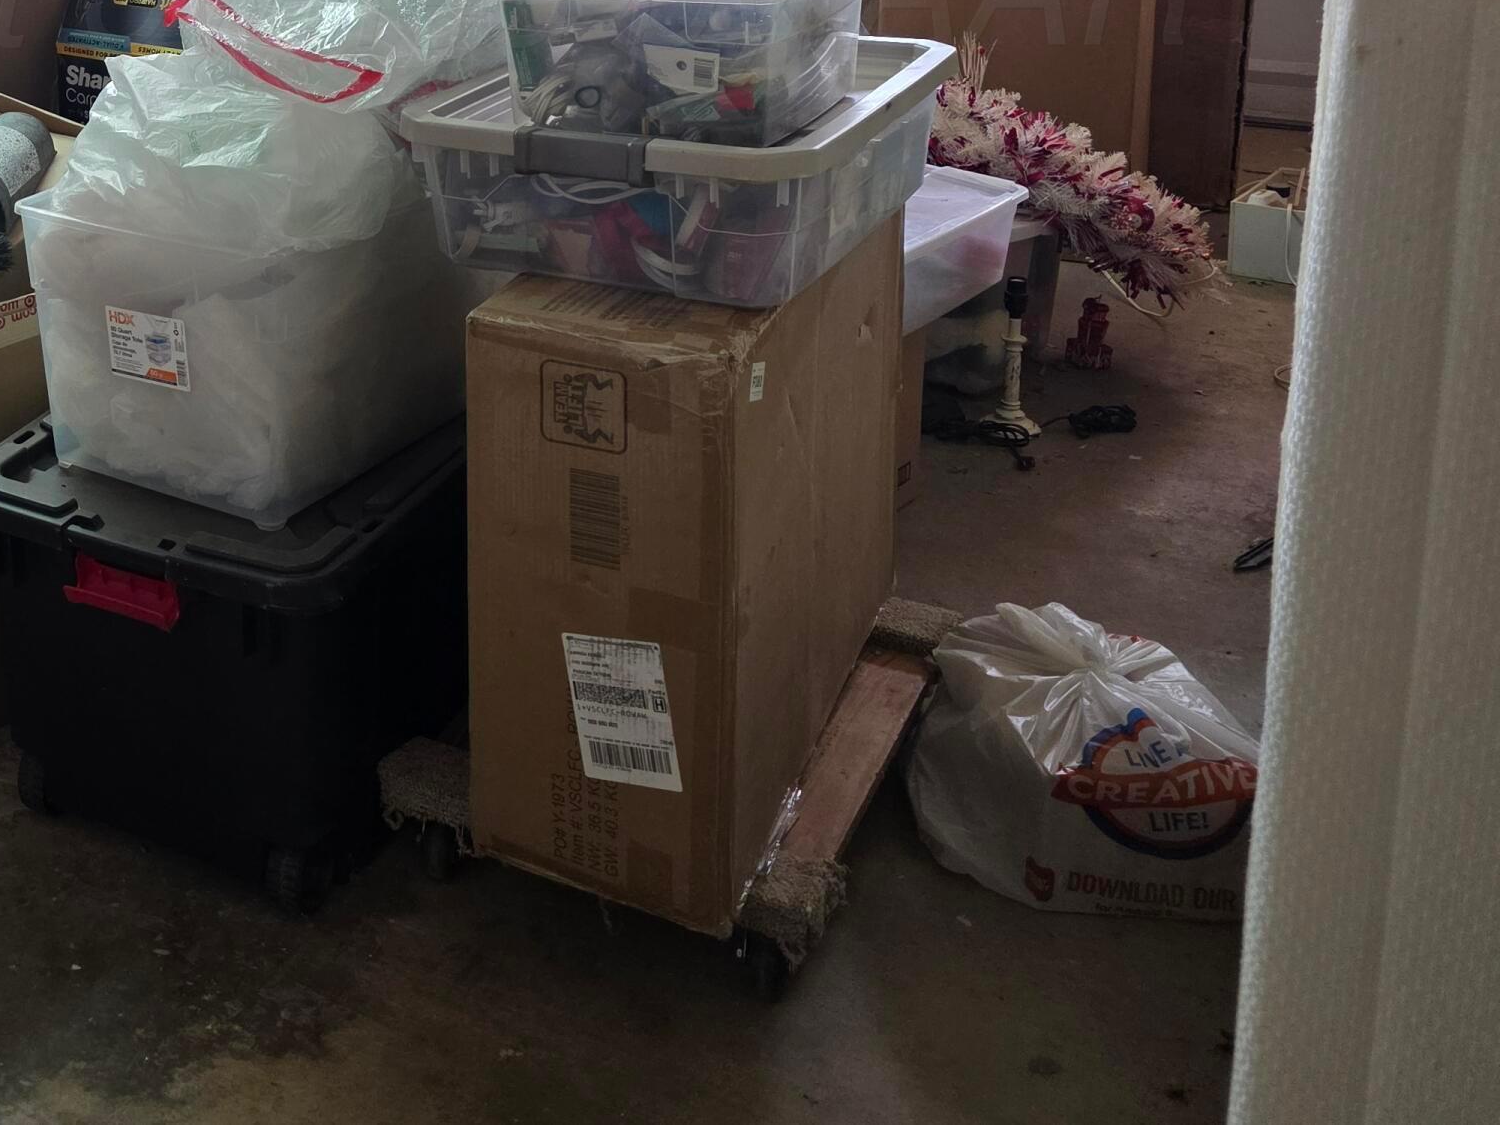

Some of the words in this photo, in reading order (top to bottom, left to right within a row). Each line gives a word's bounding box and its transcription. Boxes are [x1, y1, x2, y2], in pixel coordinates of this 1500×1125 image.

[64, 46, 94, 57] DESIGNED
[108, 310, 135, 326] HDX
[554, 382, 567, 422] TEAM
[1124, 741, 1172, 768] LIVE
[1067, 761, 1258, 803] CREATIVE
[1148, 811, 1210, 832] LIFE!
[554, 827, 567, 859] PO#
[1067, 871, 1184, 907] DOWNLOAD
[1193, 887, 1238, 912] OUR
